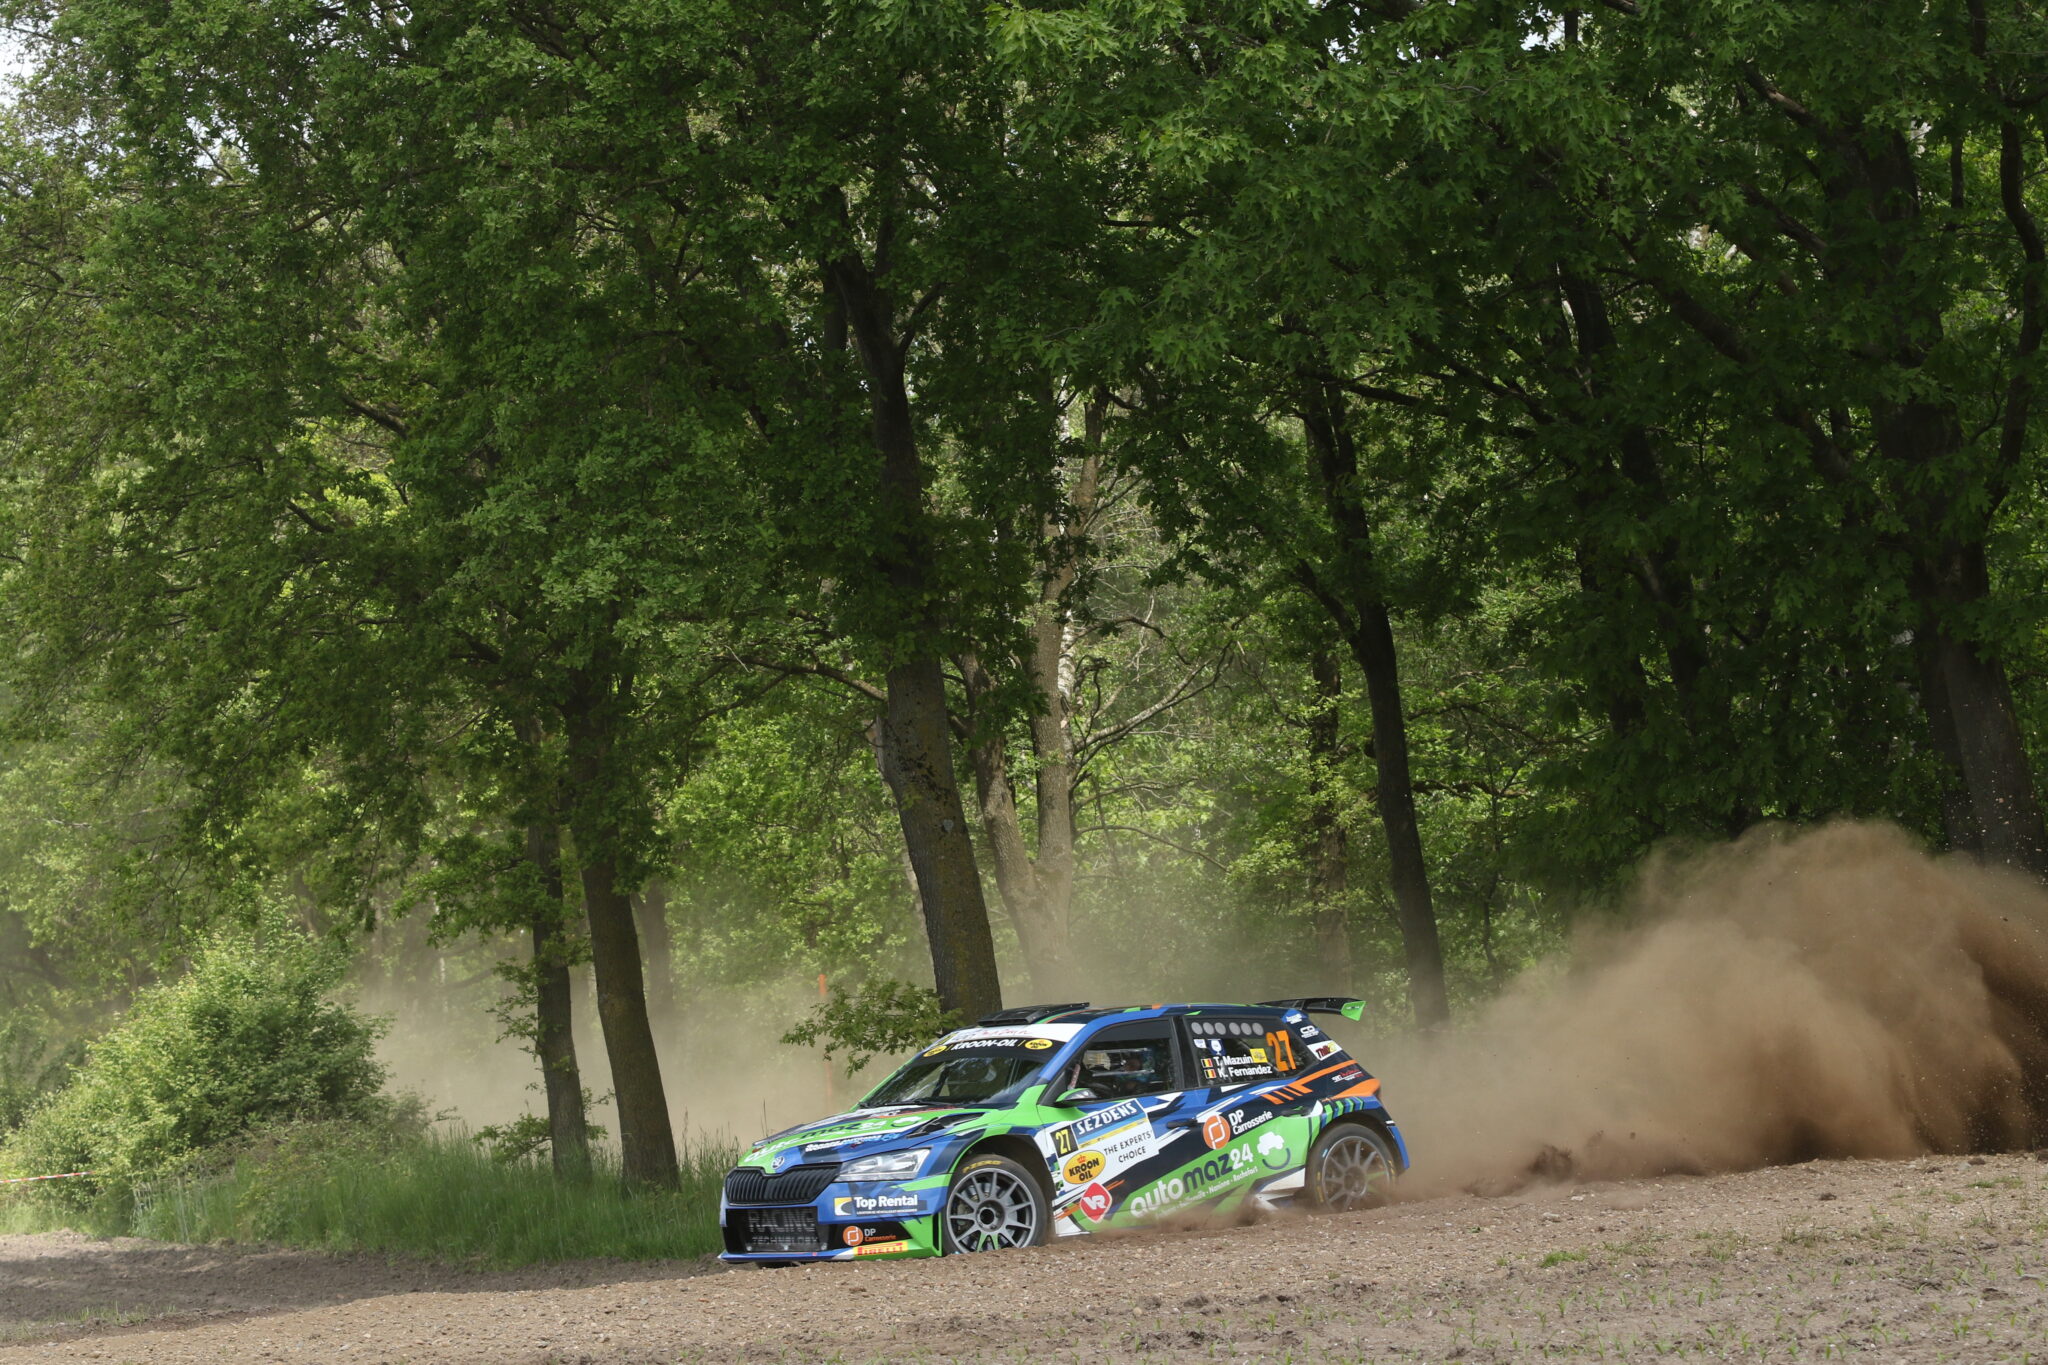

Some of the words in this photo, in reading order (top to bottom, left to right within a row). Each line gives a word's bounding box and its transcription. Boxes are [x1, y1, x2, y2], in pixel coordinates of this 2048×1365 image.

[951, 1039, 1018, 1051] KROON-OIL
[1265, 1030, 1296, 1071] 27
[1212, 1057, 1222, 1067] T.
[1222, 1054, 1254, 1066] Mazuin
[1217, 1067, 1229, 1078] K.
[1228, 1064, 1273, 1077] Fernandez
[1229, 1109, 1245, 1126] DP
[1233, 1109, 1273, 1135] Carrosserie
[1055, 1129, 1071, 1154] 27
[1103, 1144, 1118, 1155] THE
[1118, 1147, 1146, 1163] CHOICE
[1068, 1157, 1100, 1177] KROON
[1079, 1171, 1093, 1182] OIL
[1130, 1143, 1254, 1218] automaz24
[854, 1197, 877, 1209] Top
[878, 1194, 918, 1207] Rental
[864, 1228, 876, 1236] DP
